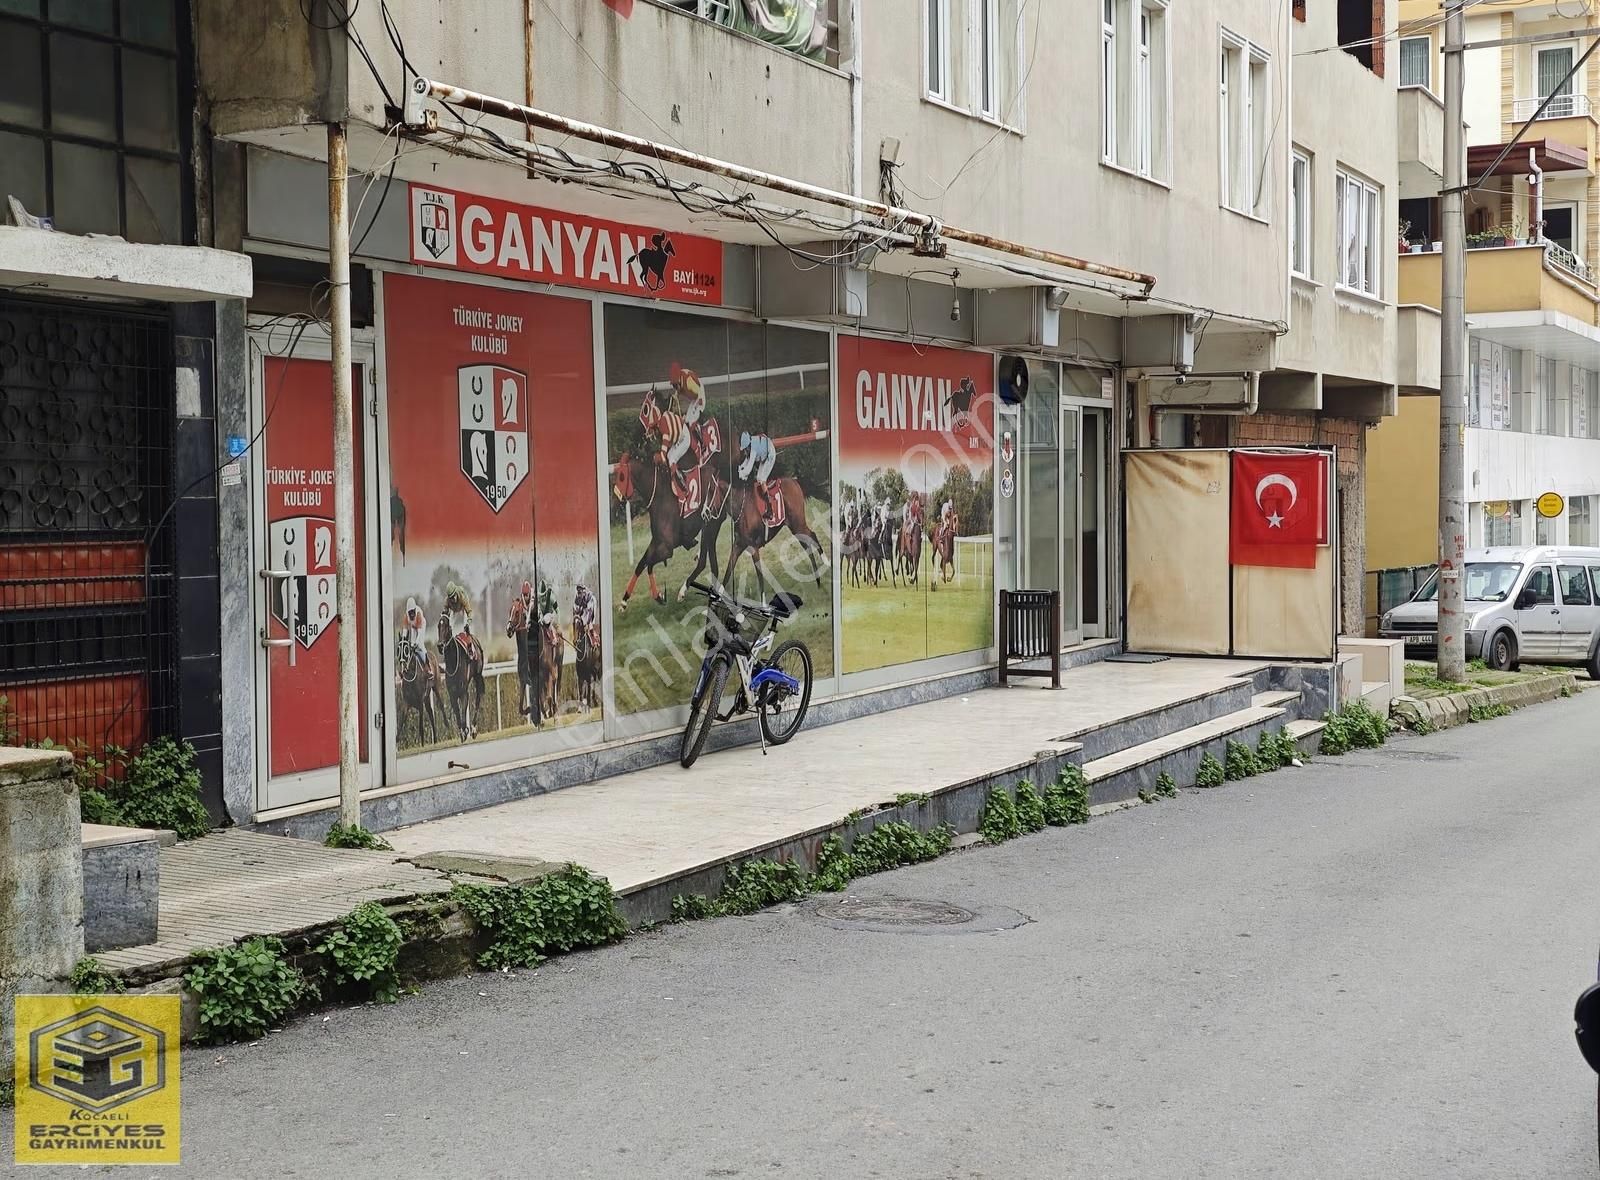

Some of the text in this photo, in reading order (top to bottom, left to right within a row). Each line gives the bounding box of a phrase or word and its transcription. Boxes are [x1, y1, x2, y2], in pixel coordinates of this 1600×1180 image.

[461, 204, 646, 287] GANYAN
[452, 305, 523, 333] TÜRKİYE JOKEY
[471, 333, 508, 355] KULÜBÜ
[856, 369, 952, 432] GANYAN
[707, 425, 718, 452] 3
[266, 466, 306, 485] TÜRKİYE
[283, 487, 321, 506] KULÜBÜ
[485, 485, 507, 499] 1950
[687, 478, 699, 509] 2
[296, 623, 319, 637] 1950
